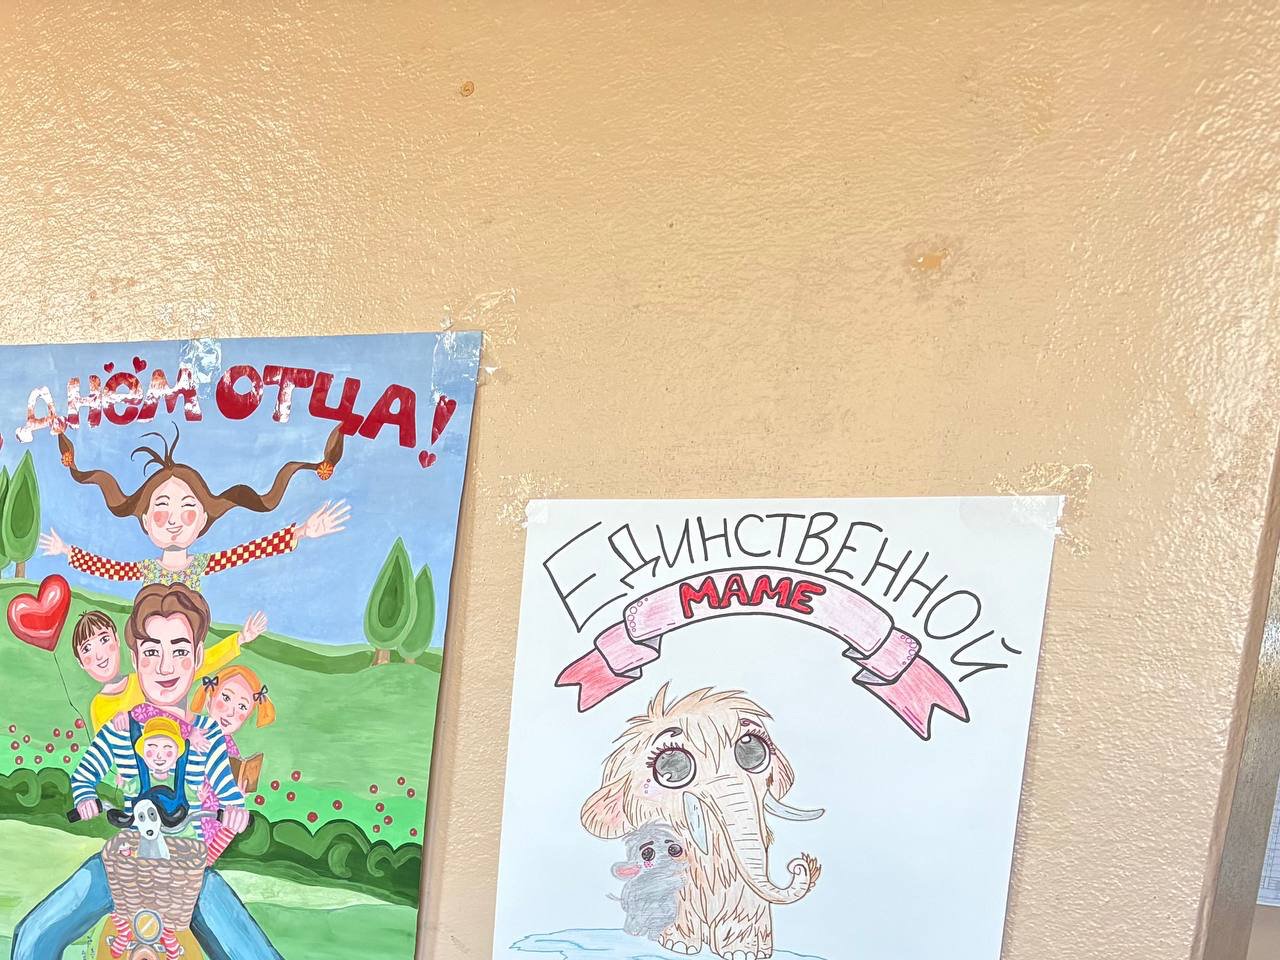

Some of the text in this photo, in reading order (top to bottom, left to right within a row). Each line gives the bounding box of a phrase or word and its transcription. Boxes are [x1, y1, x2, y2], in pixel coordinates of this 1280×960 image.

[214, 364, 457, 470] ОТЦА!
[542, 512, 1022, 683] ЕДИНСТВЕННОЙ
[678, 576, 827, 617] МАМЕ
